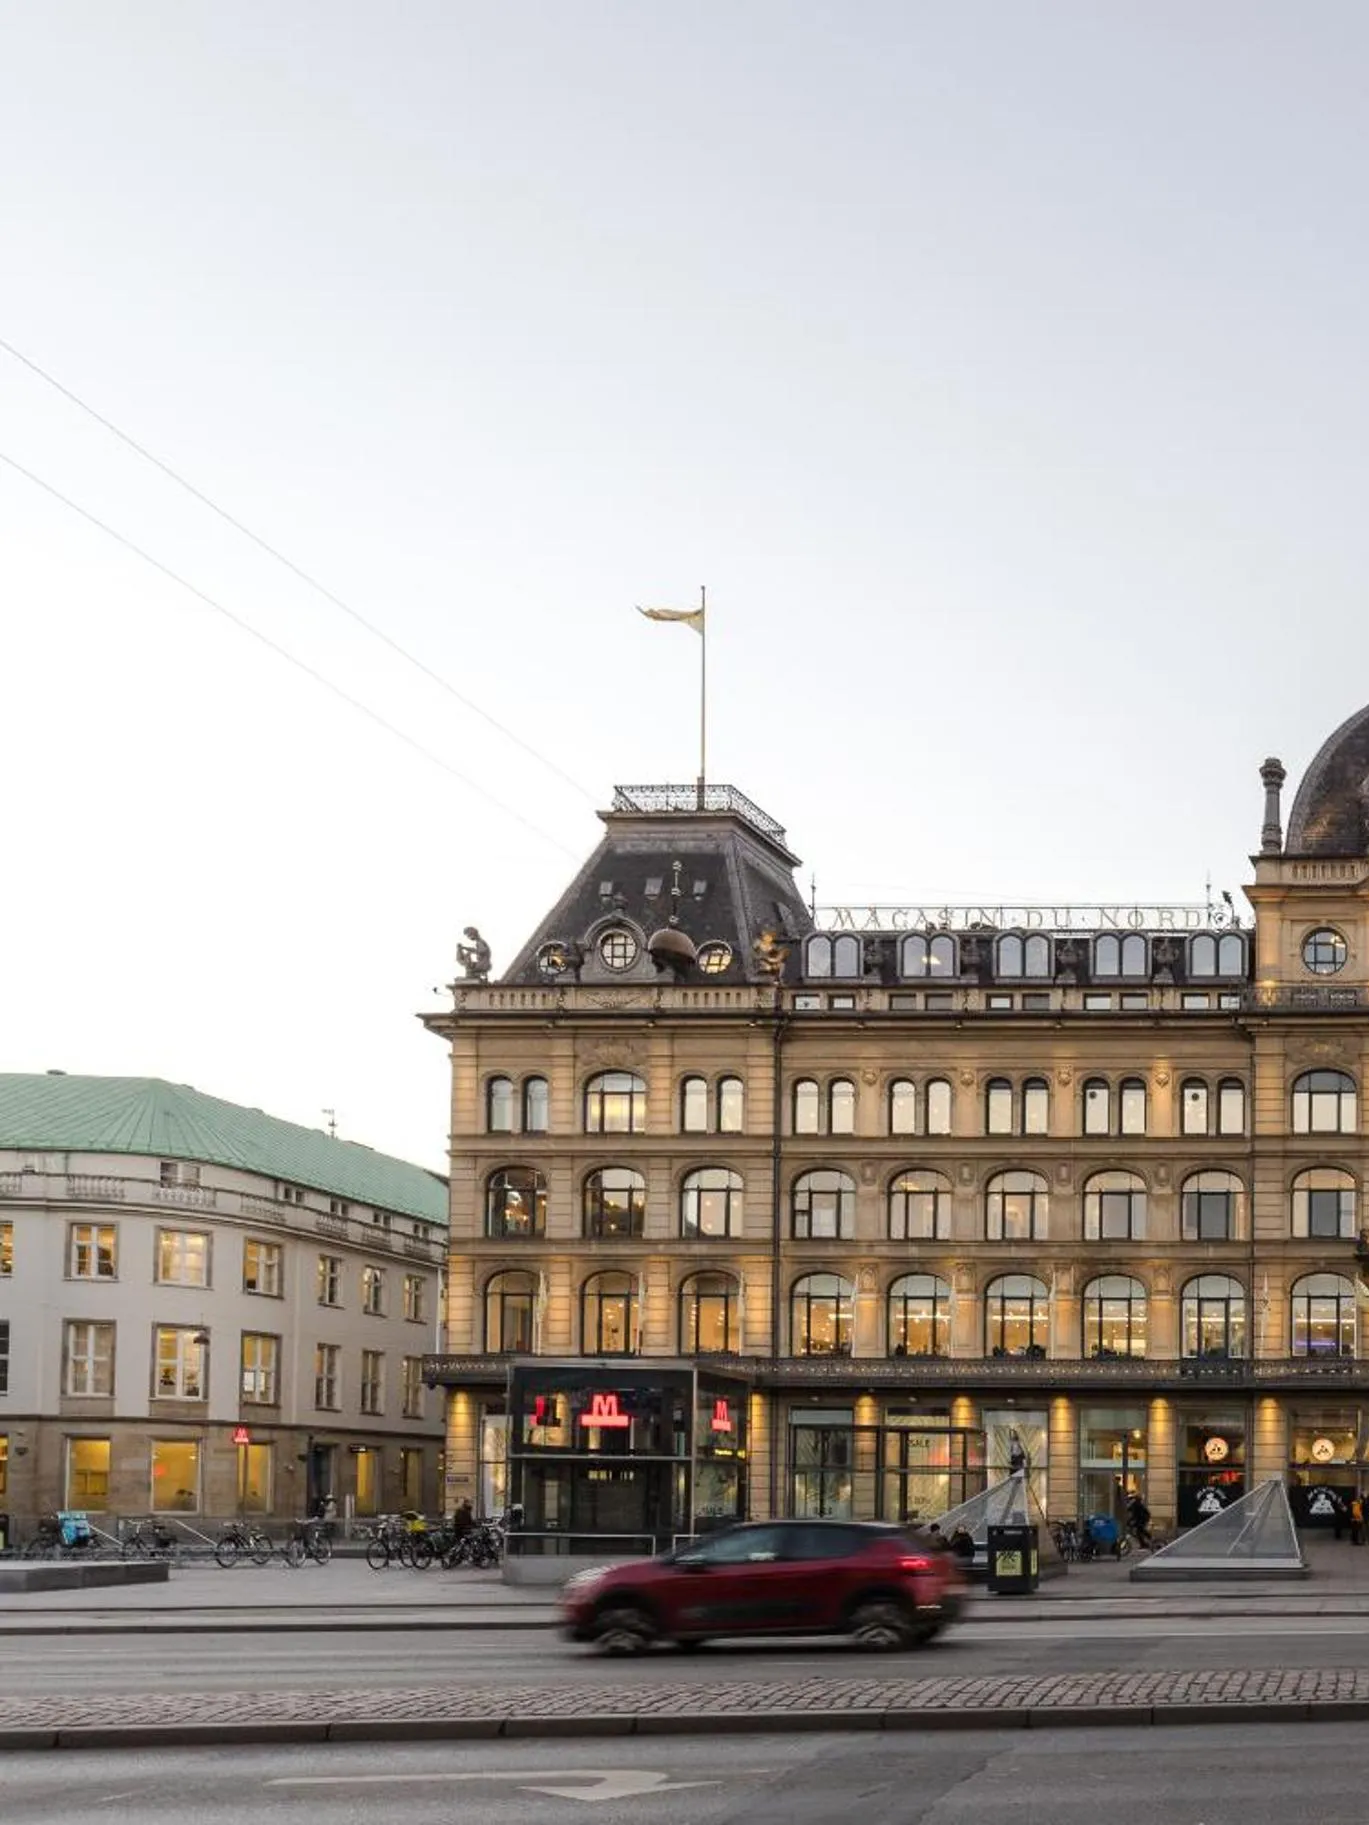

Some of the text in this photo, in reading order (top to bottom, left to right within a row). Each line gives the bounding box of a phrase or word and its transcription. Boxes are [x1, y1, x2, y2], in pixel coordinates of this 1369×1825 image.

[829, 907, 1202, 930] MAGASIN DU NORD
